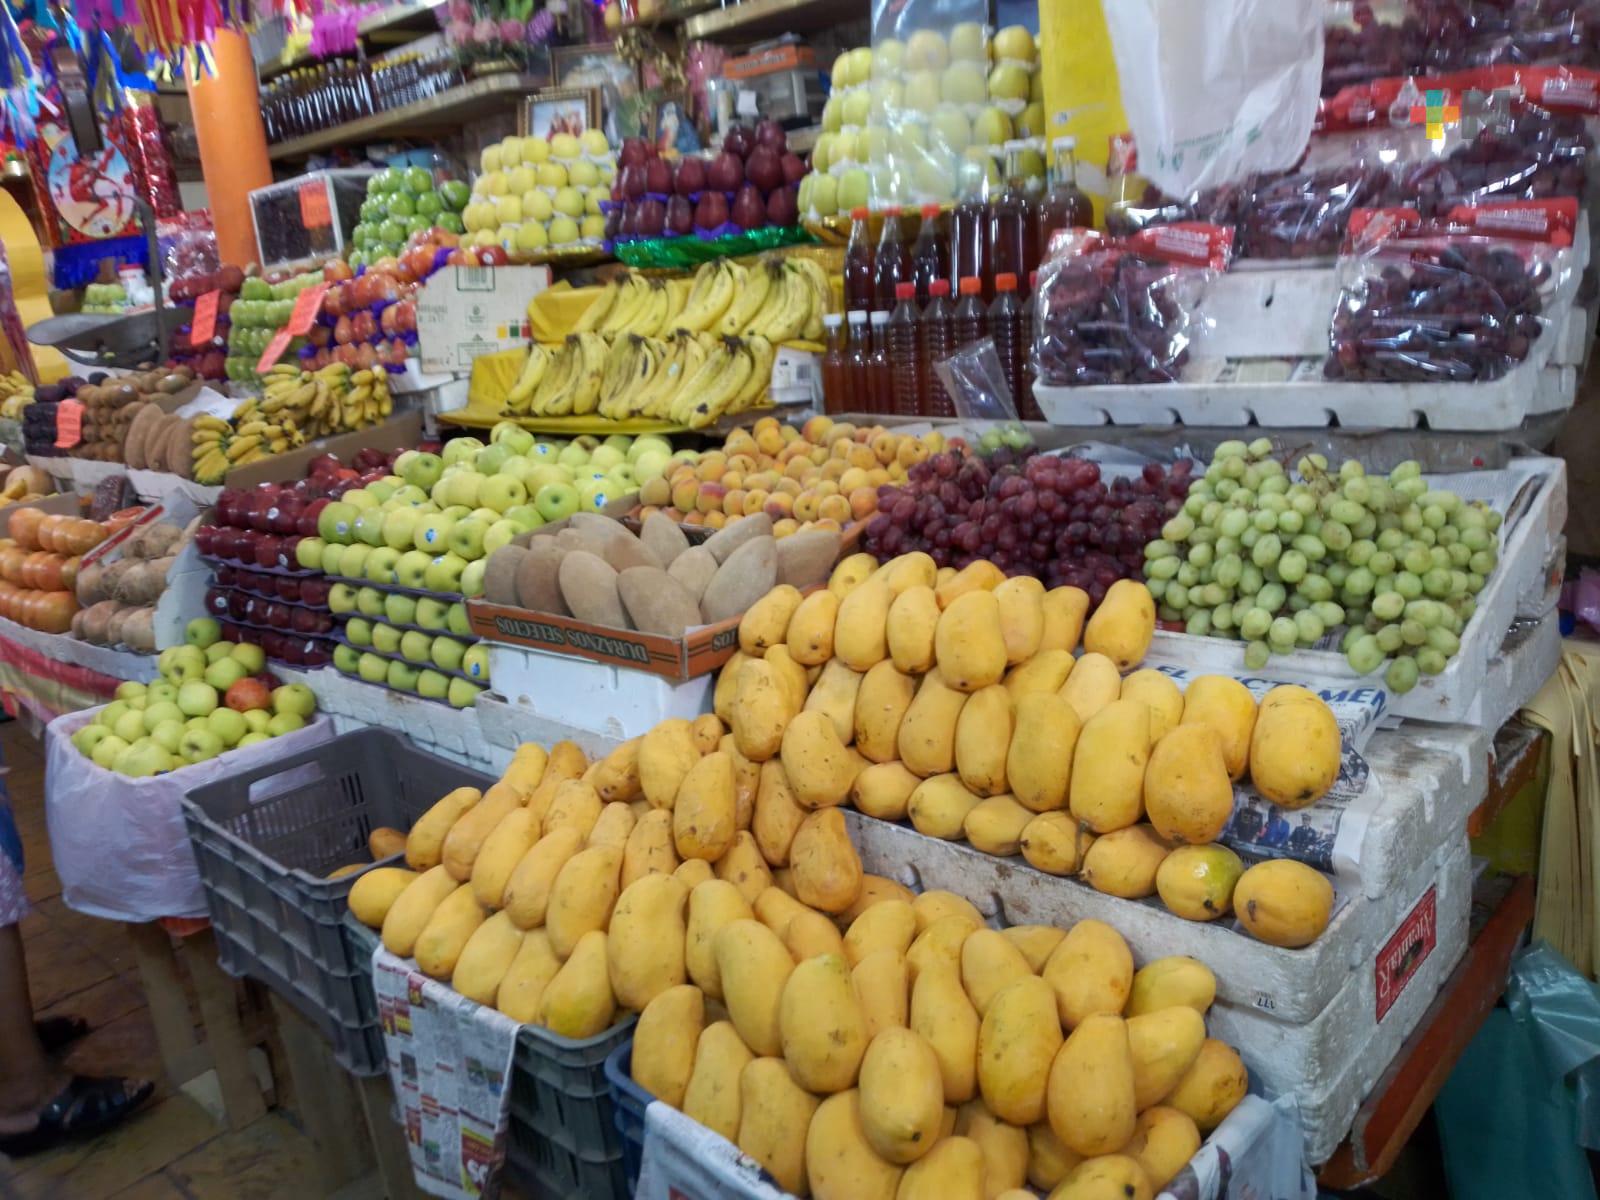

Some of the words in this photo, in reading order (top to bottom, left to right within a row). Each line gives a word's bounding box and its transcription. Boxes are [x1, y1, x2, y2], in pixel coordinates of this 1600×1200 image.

[496, 615, 565, 645] SELECTOS
[567, 628, 649, 663] DURAZNOS
[1157, 665, 1188, 679] EL
